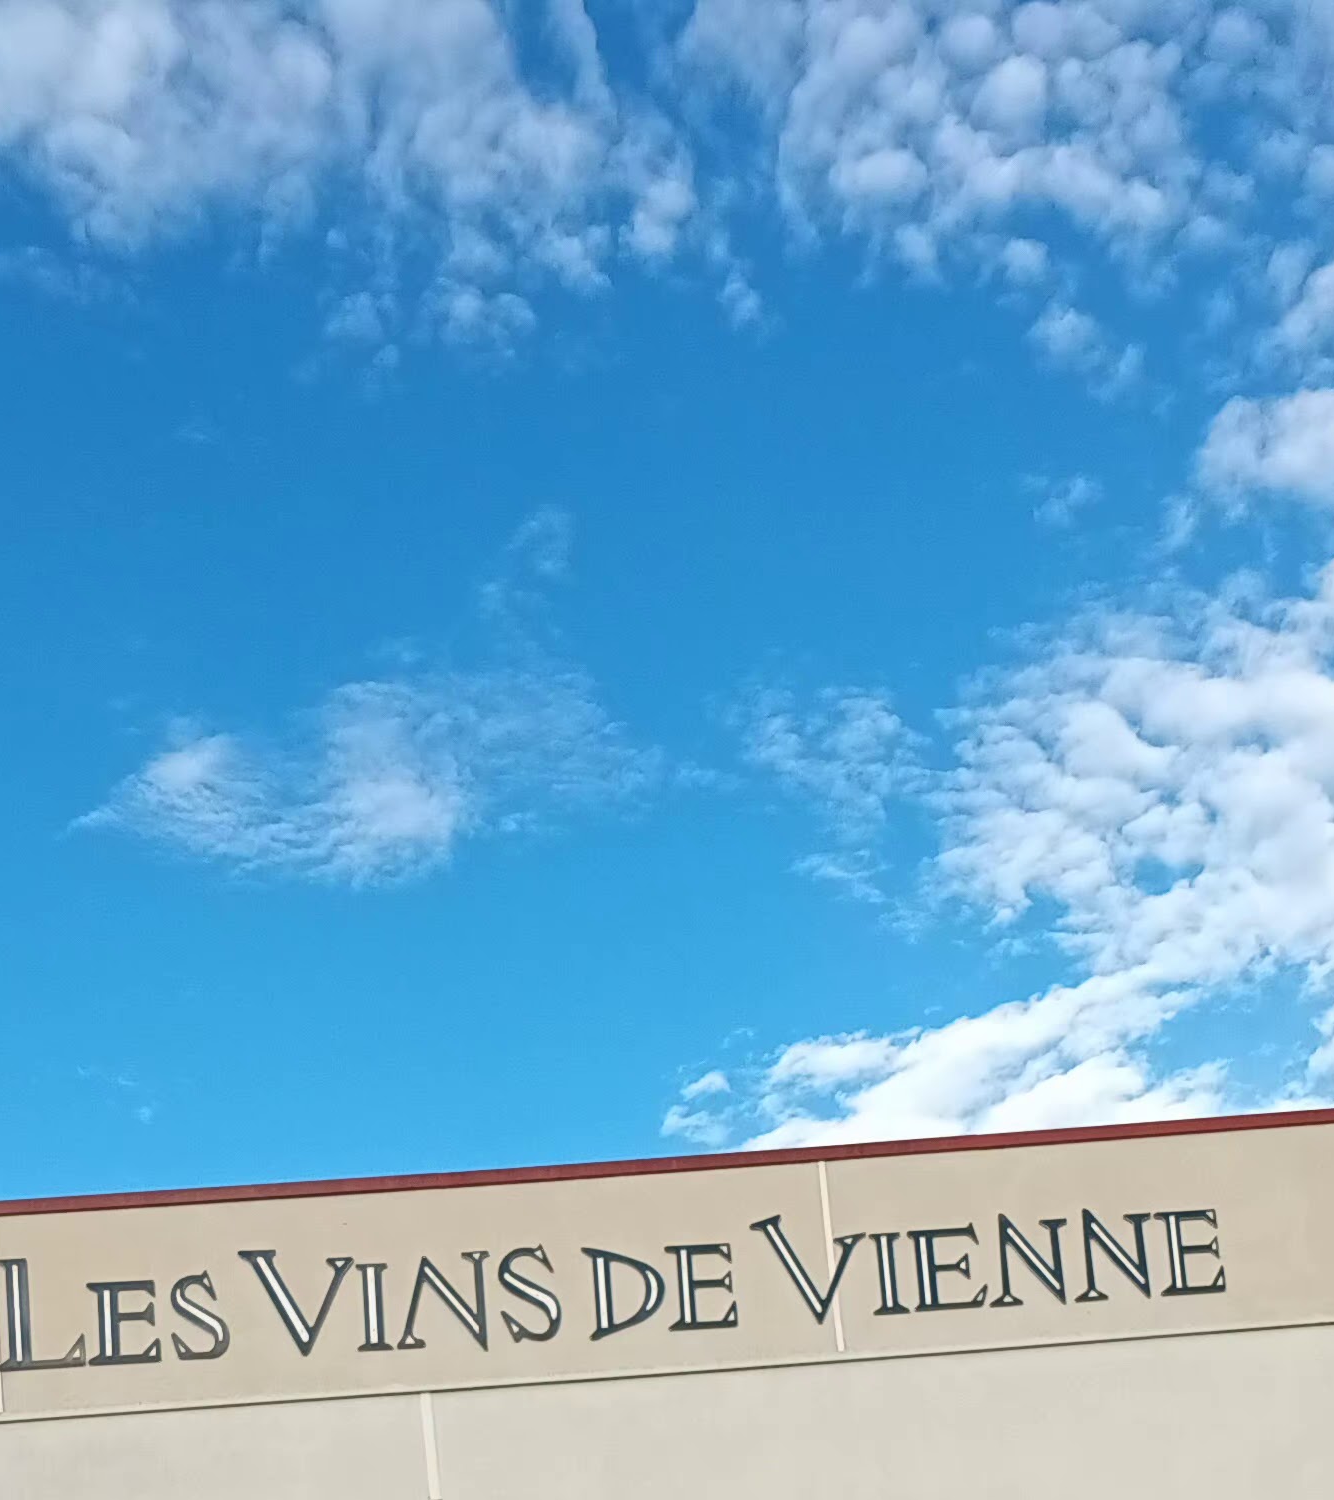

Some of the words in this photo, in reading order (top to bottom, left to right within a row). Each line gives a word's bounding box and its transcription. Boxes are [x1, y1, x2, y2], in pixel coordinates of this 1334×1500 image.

[237, 1243, 562, 1357] VINS
[580, 1242, 739, 1342] DE
[748, 1207, 1227, 1326] VIENNE
